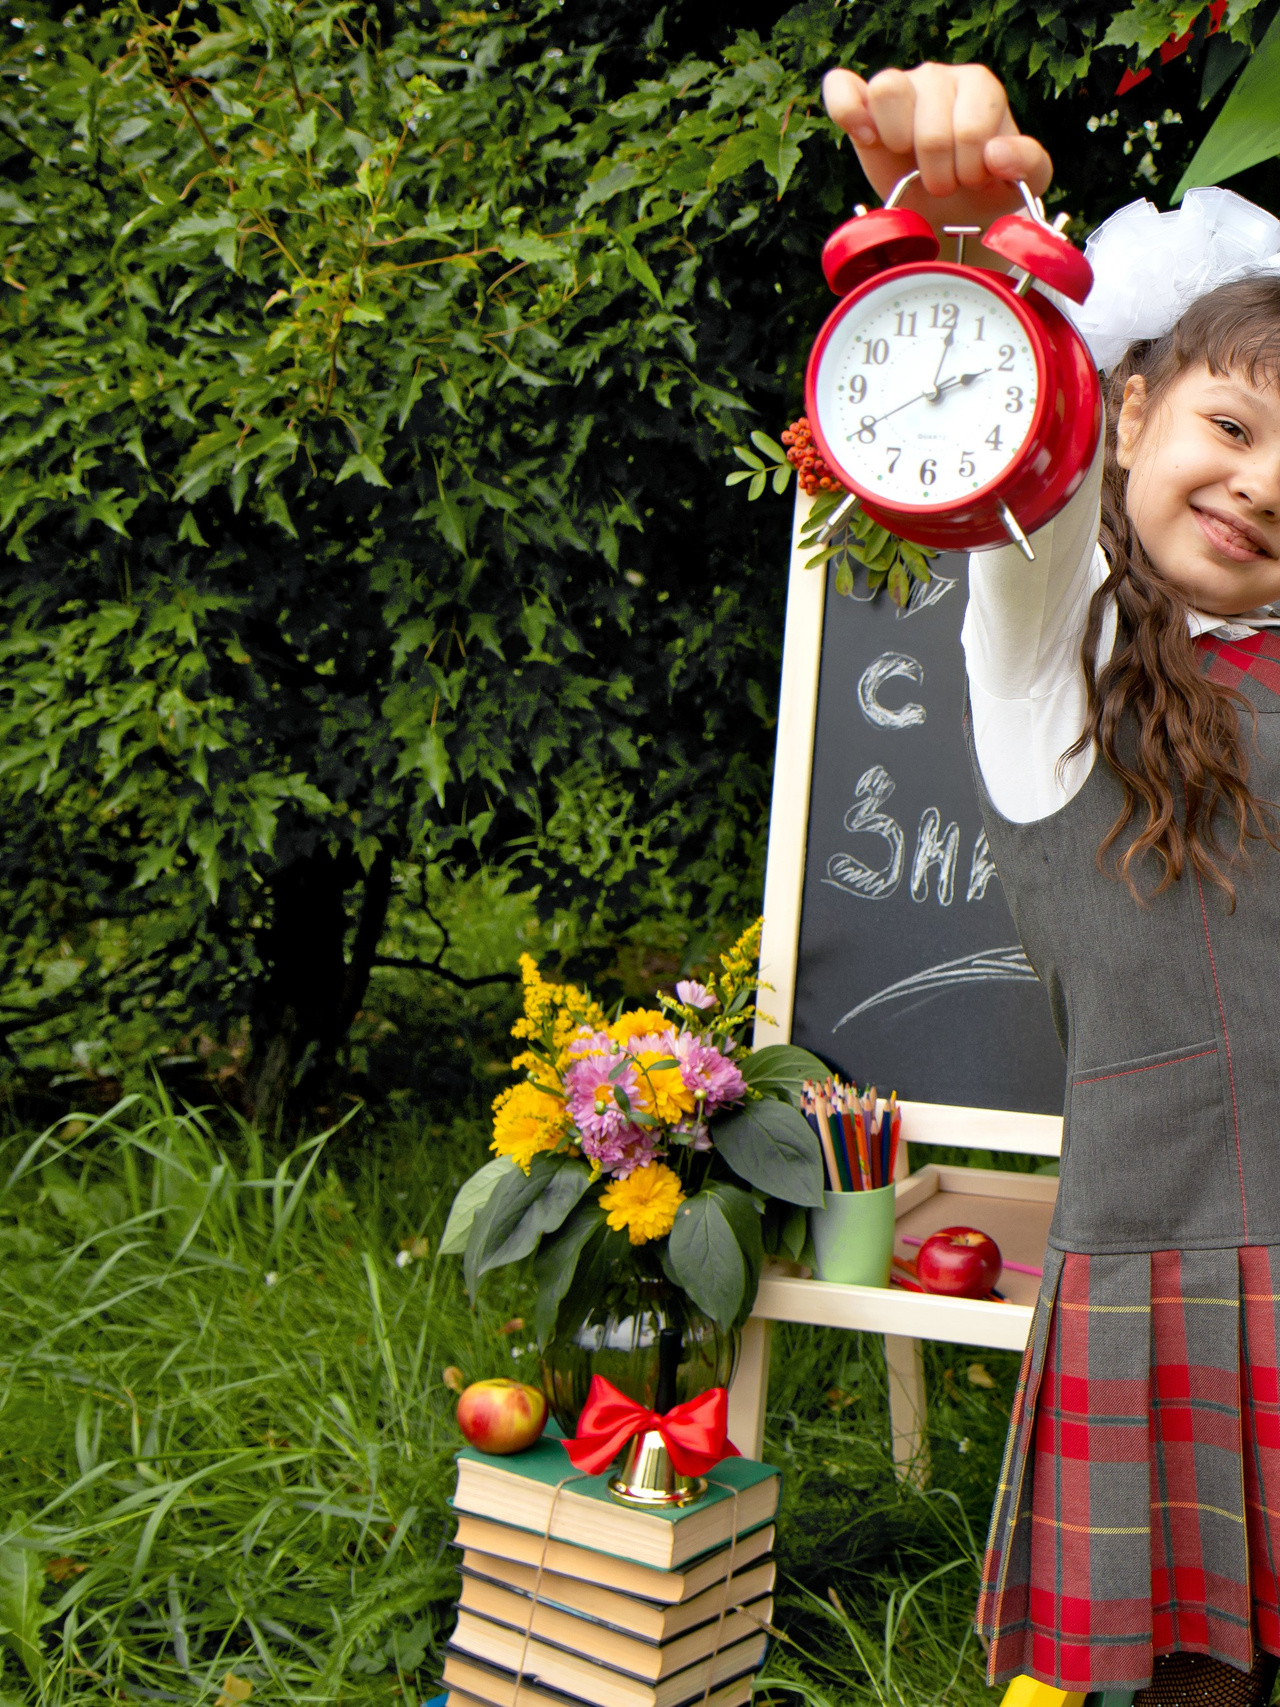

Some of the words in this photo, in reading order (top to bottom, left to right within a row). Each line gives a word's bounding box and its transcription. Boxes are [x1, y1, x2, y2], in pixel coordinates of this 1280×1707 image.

[894, 311, 917, 337] 11
[929, 303, 960, 329] 12
[974, 316, 985, 341] 1
[862, 338, 889, 365] 10
[997, 345, 1015, 371] 2
[849, 375, 867, 404] 9
[1005, 386, 1023, 413] 3
[858, 415, 877, 444] 8
[985, 425, 1003, 451] 4
[886, 447, 901, 473] 7
[919, 459, 937, 485] 6
[958, 451, 975, 477] 5
[857, 650, 927, 730] С
